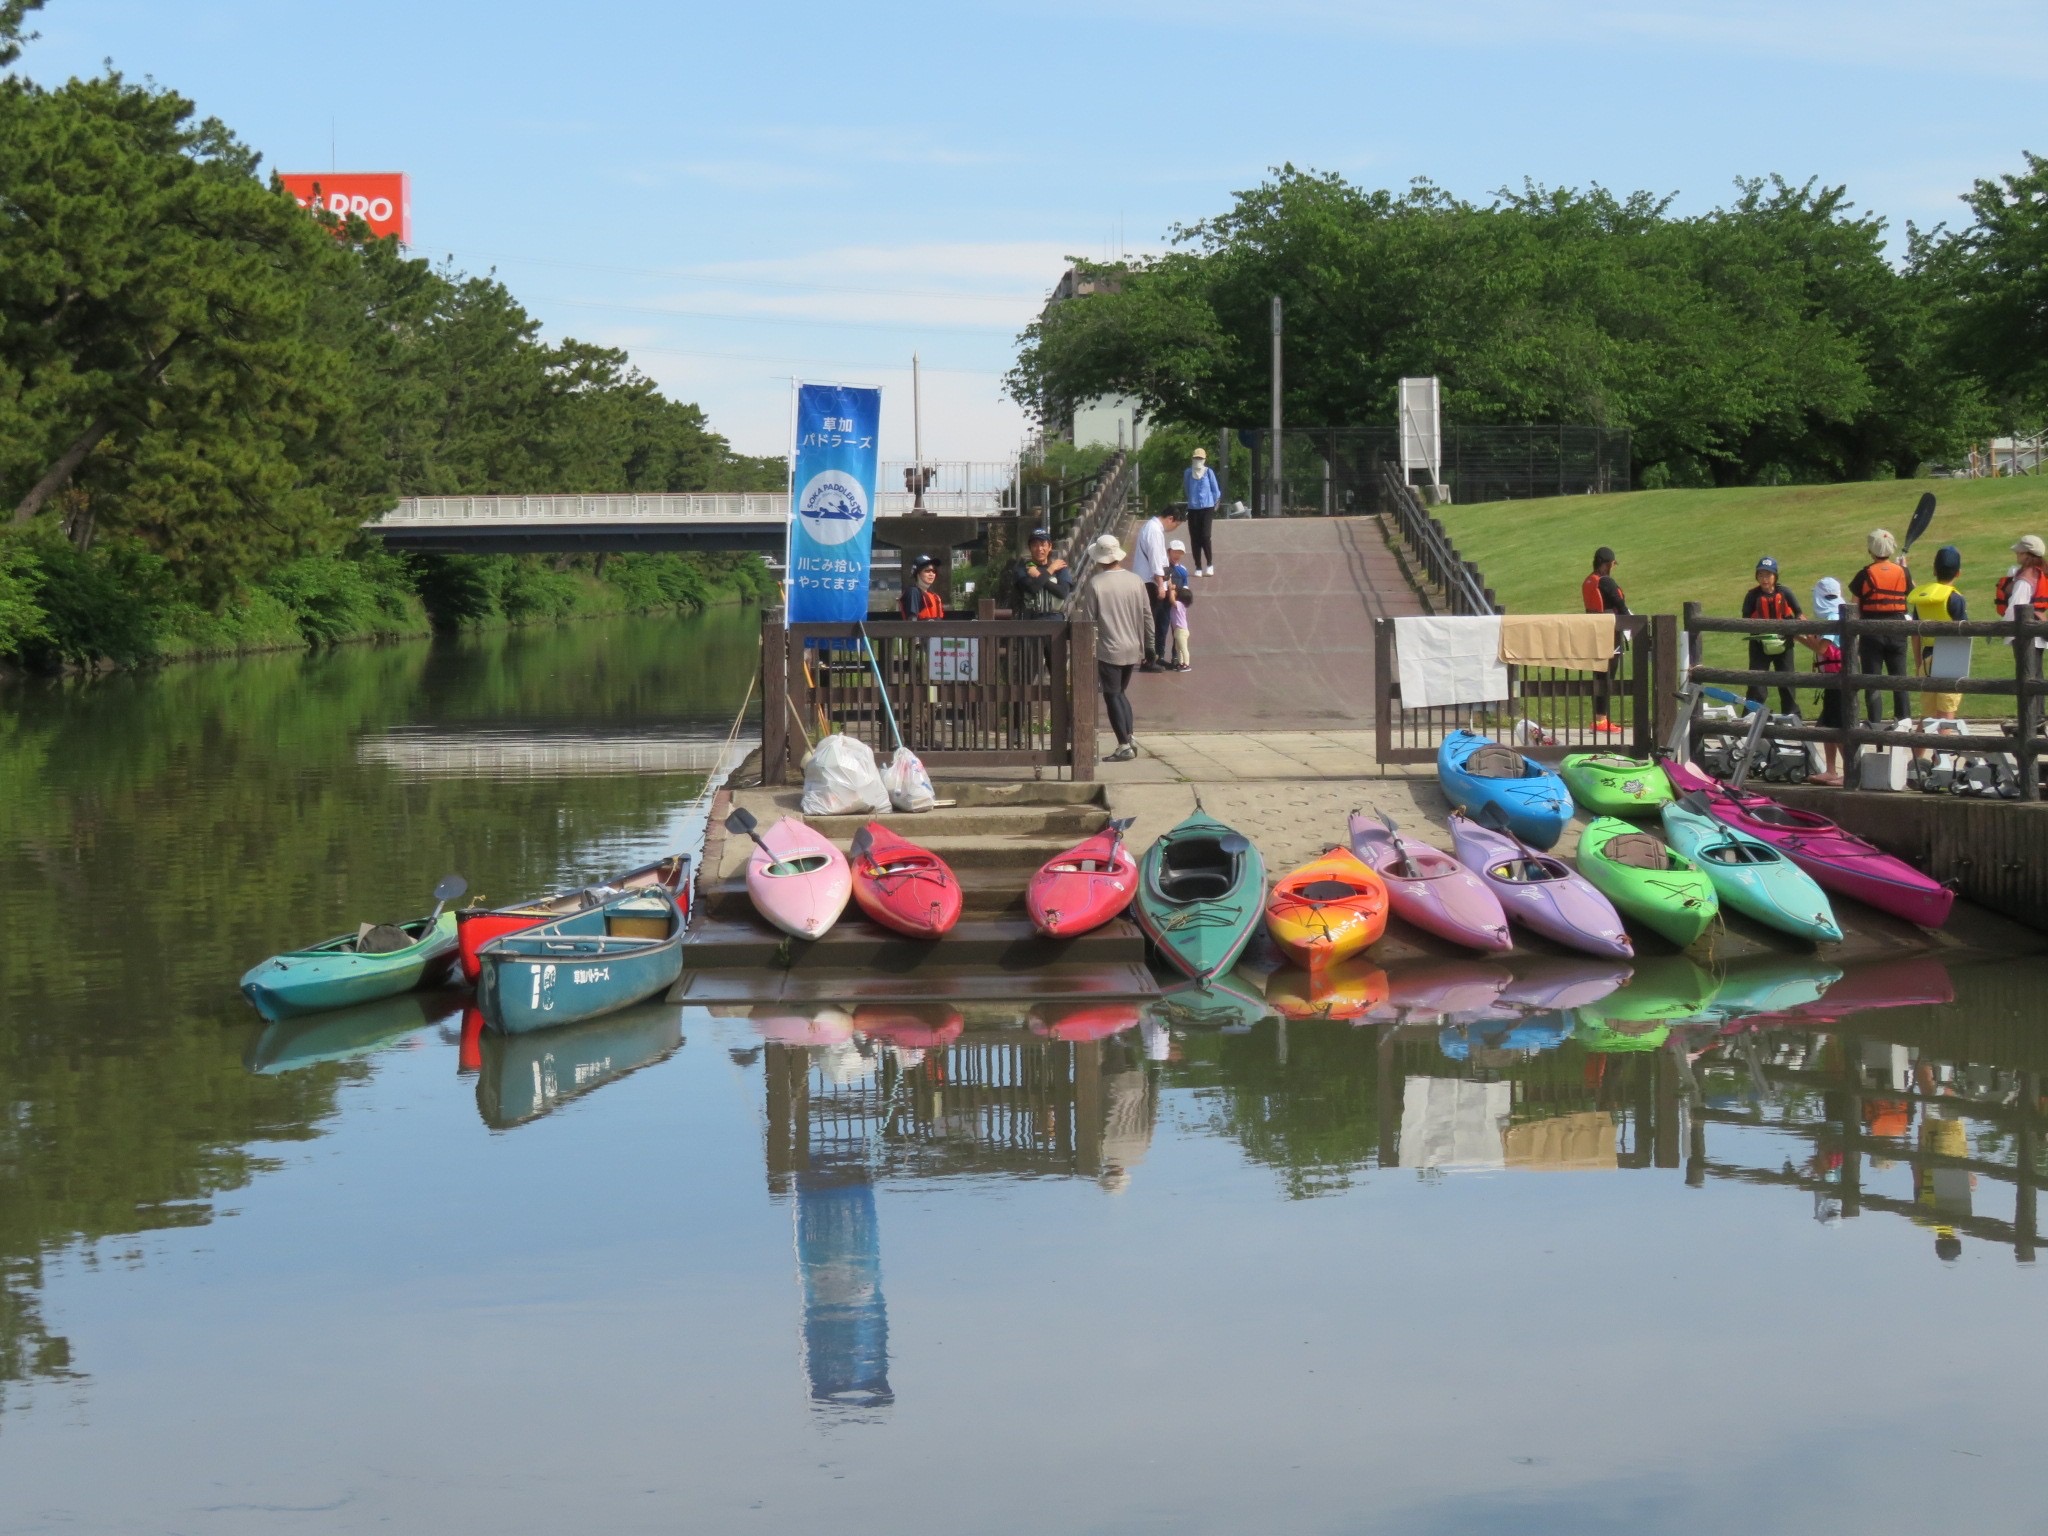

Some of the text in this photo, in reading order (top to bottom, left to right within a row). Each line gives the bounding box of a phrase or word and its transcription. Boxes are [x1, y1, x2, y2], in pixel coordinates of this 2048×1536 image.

[822, 417, 853, 433] 草加
[803, 433, 872, 449] パドラーズ
[807, 488, 823, 509] SOKA
[823, 484, 856, 507] PADDLERS
[798, 557, 861, 573] 川ごみ拾い
[799, 576, 859, 590] やってます
